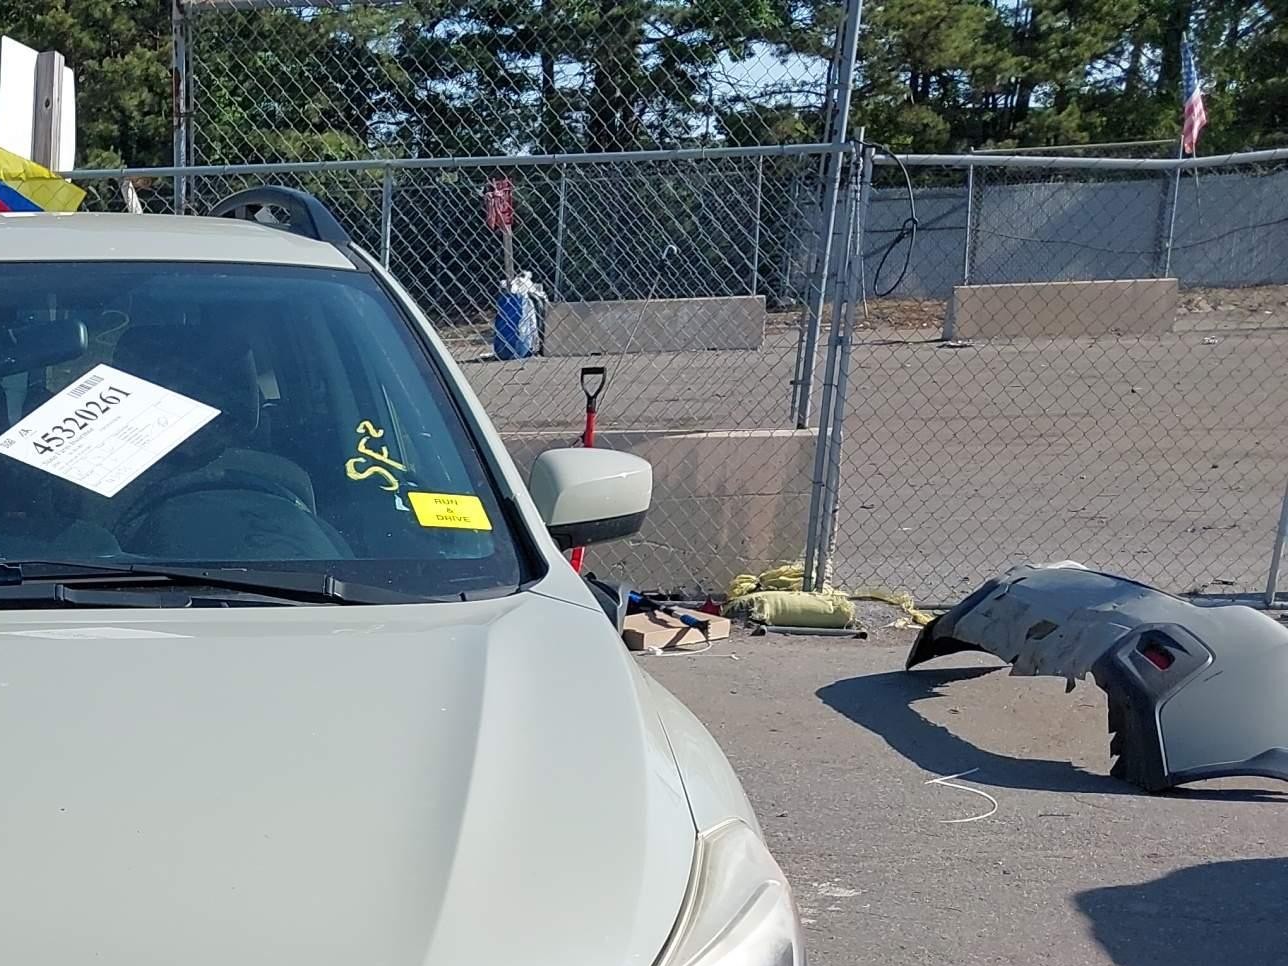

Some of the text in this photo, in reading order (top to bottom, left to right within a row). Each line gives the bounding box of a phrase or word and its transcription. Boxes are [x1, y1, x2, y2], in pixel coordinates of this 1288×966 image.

[32, 385, 132, 456] 45320261
[434, 498, 458, 506] RUN
[435, 514, 472, 523] DRIVE
